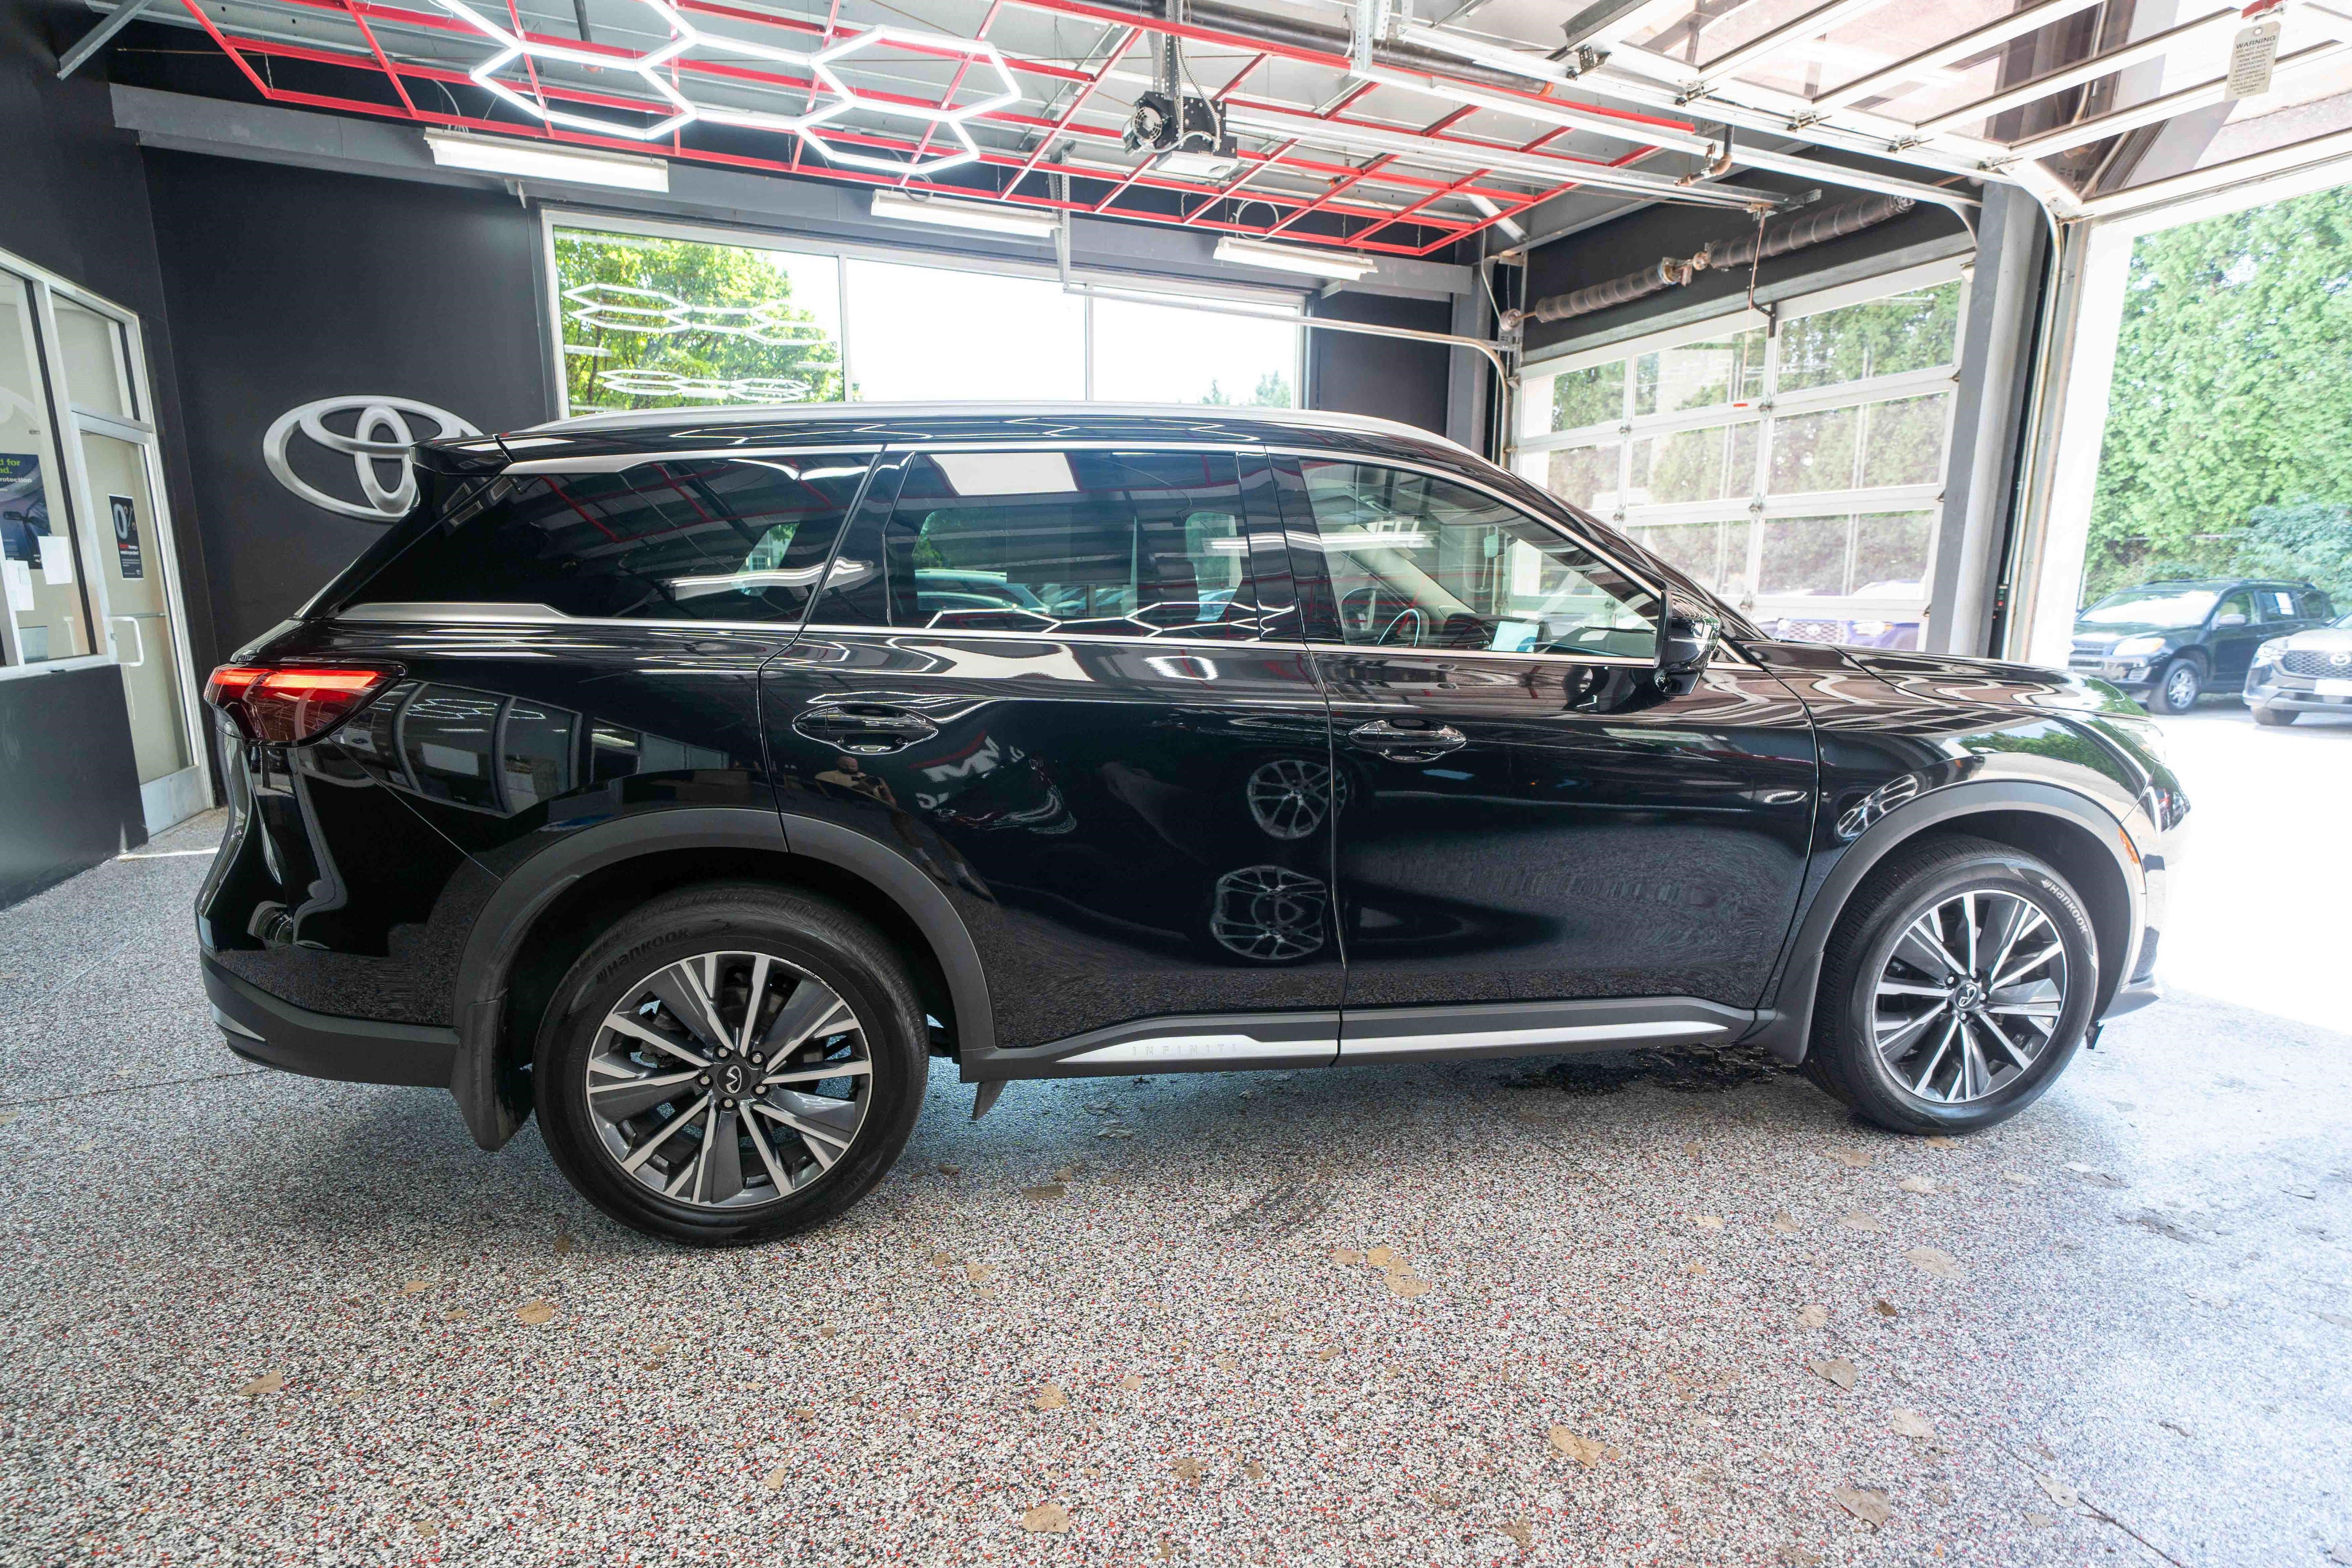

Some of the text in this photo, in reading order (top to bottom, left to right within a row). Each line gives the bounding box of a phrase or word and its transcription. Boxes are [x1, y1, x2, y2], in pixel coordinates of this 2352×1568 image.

[2236, 35, 2276, 49] WARNING
[2235, 62, 2266, 73] EMERGENCY
[2237, 59, 2266, 68] OPERATING
[2234, 67, 2265, 78] DISCONNECT
[1133, 1044, 1236, 1056] INFINITI
